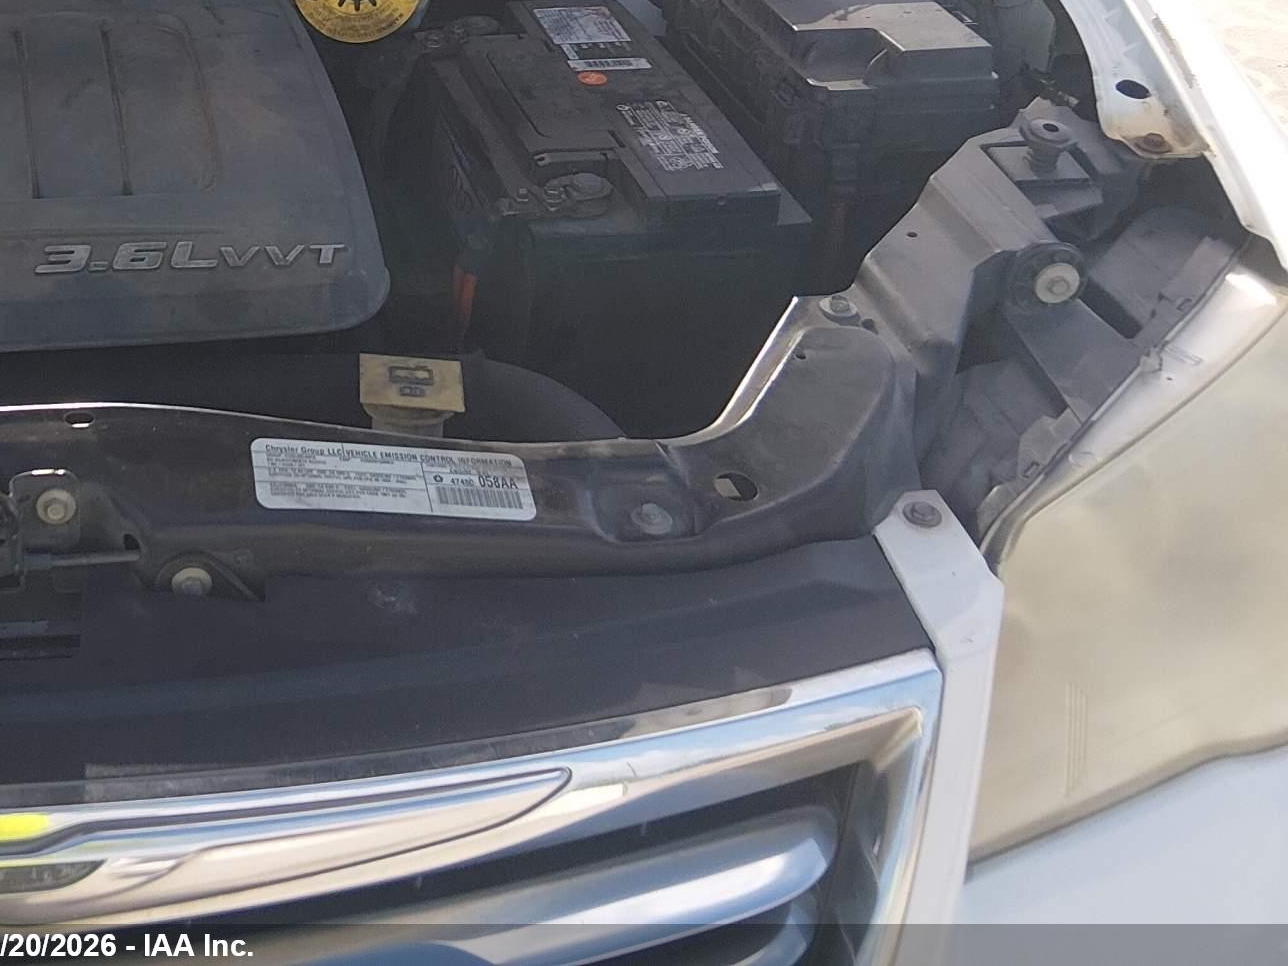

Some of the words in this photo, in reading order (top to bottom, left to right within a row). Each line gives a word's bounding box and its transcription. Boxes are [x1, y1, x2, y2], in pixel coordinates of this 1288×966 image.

[265, 443, 298, 454] Chrysler
[300, 445, 325, 455] Group
[327, 447, 342, 456] LLC
[345, 449, 378, 459] VEHICLE
[380, 451, 418, 461] EMISSION
[420, 453, 454, 464] CONTROL
[457, 456, 512, 467] INFORMATION
[478, 474, 519, 490] 058AA
